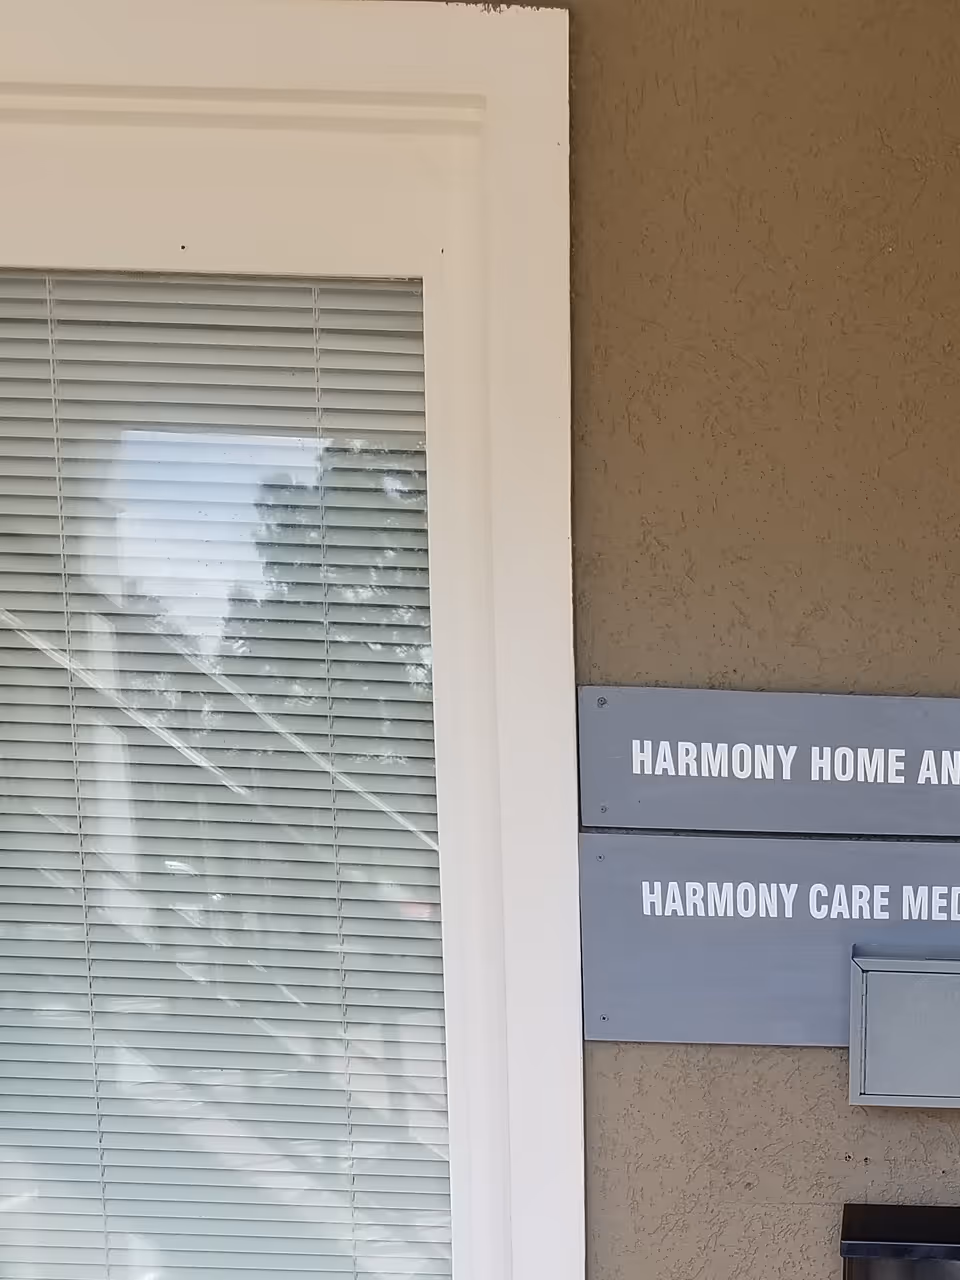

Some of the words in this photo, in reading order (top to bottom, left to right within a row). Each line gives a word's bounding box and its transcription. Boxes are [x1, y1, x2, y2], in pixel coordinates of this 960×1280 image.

[631, 739, 798, 780] HARMONY
[811, 746, 906, 784] HOME
[641, 880, 799, 919] HARMONY
[808, 883, 891, 921] CARE
